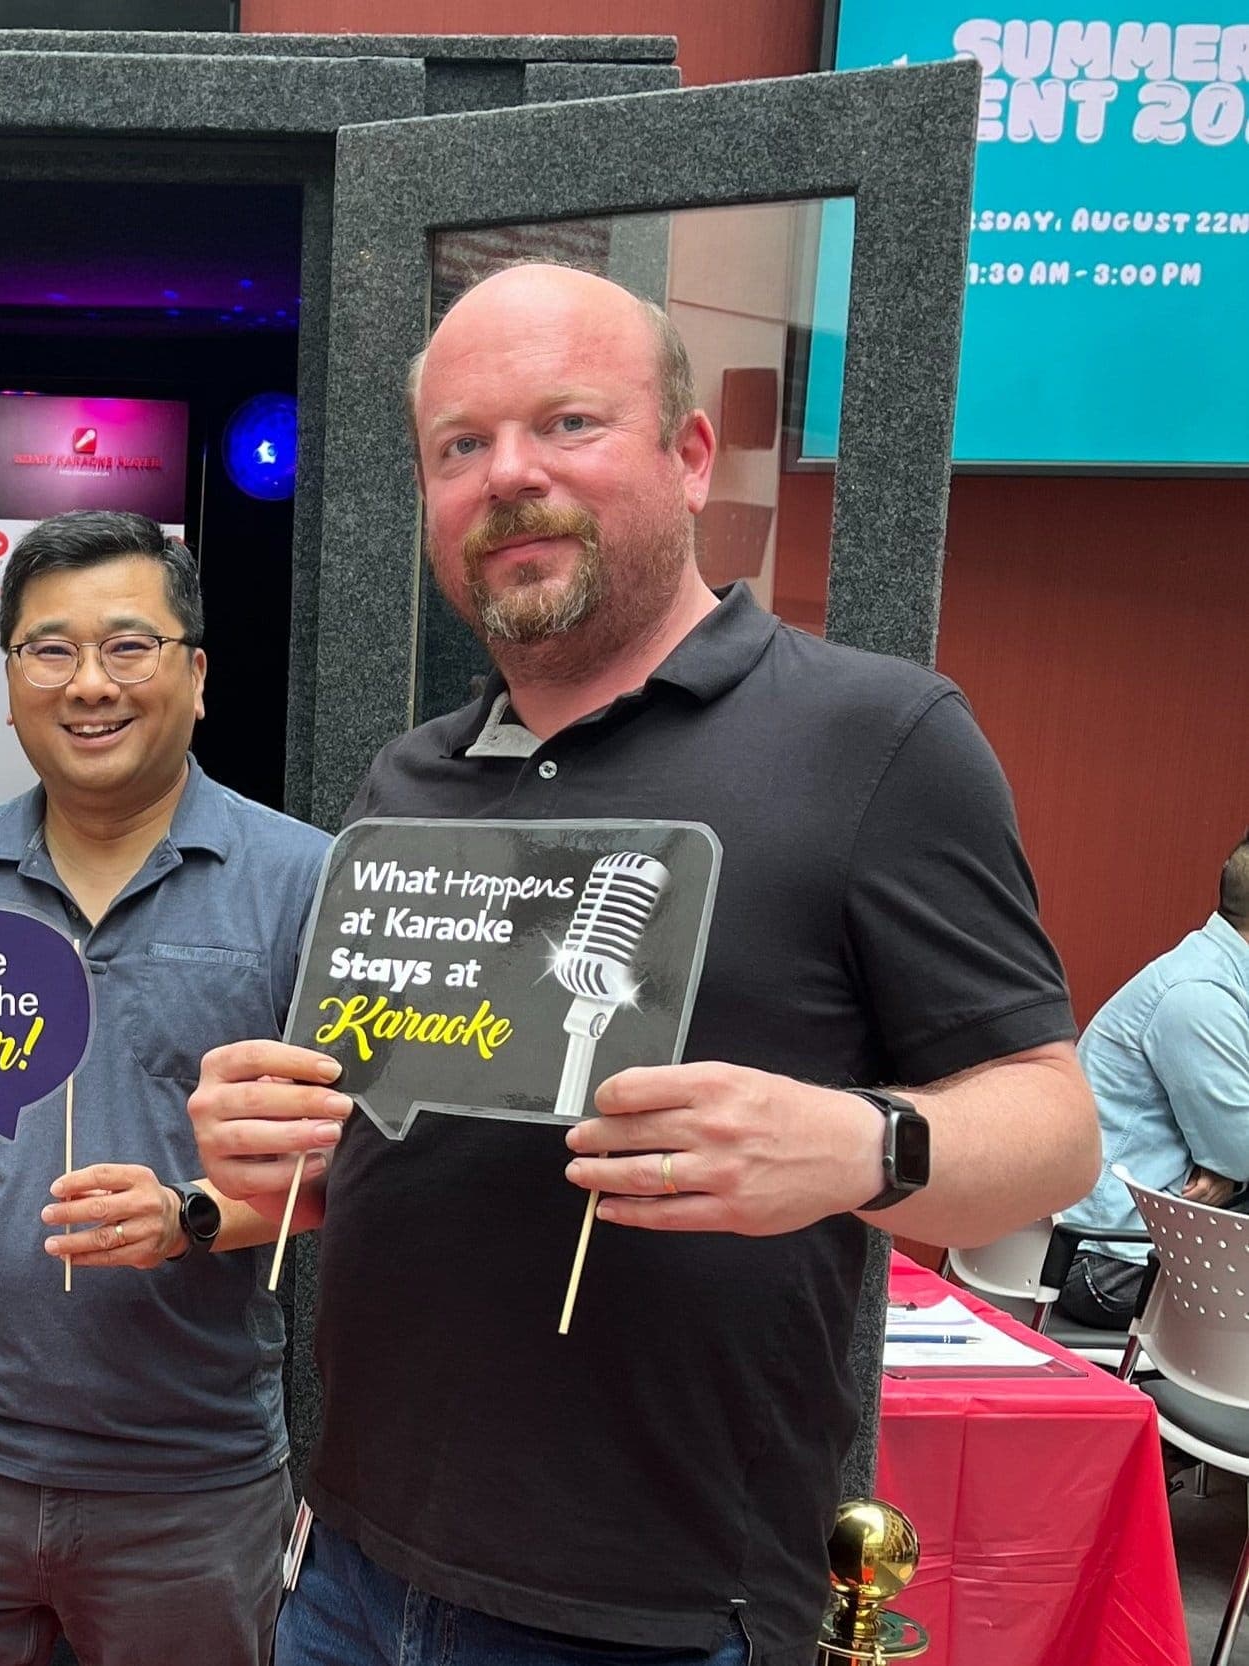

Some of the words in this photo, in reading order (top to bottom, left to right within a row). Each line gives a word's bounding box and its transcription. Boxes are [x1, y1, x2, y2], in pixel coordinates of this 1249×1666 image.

[953, 18, 1249, 83] SUMMER
[1071, 207, 1191, 235] AUGUST
[1029, 260, 1071, 286] AM
[1093, 262, 1157, 287] 3:00
[1161, 262, 1202, 287] PM
[353, 860, 440, 895] What
[444, 868, 575, 911] Happens
[340, 908, 375, 936] at
[383, 906, 514, 943] Karaoke
[330, 947, 432, 993] Stays
[445, 958, 481, 988] at
[315, 994, 514, 1062] Karaoke
